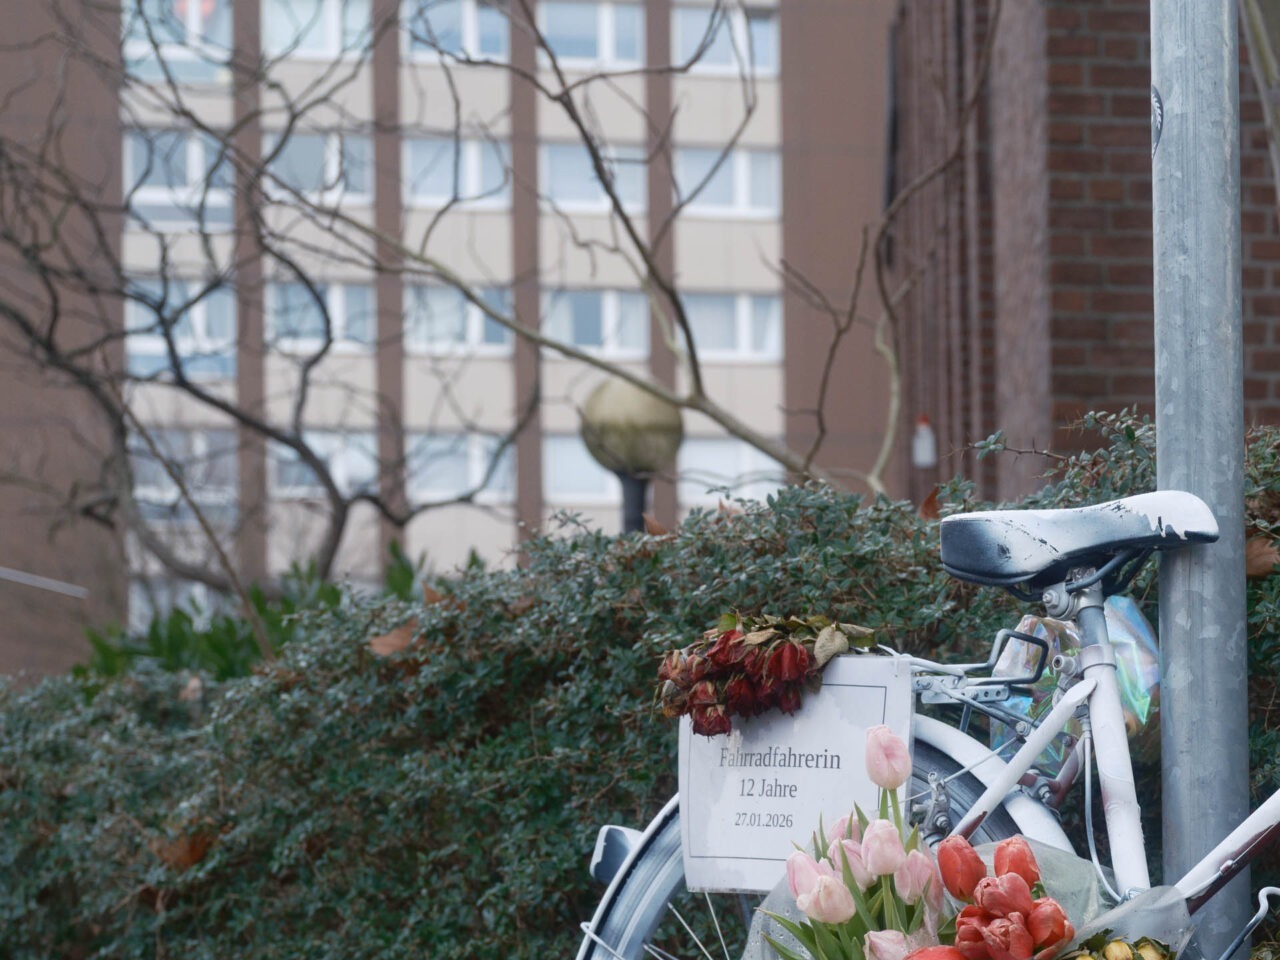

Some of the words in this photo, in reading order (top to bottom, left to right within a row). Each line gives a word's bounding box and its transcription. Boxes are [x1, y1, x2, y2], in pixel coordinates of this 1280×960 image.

[718, 747, 841, 769] Fahrradfahrerin
[739, 778, 755, 797] 12
[758, 778, 798, 798] Jahre
[734, 812, 793, 828] 27.01.2026
